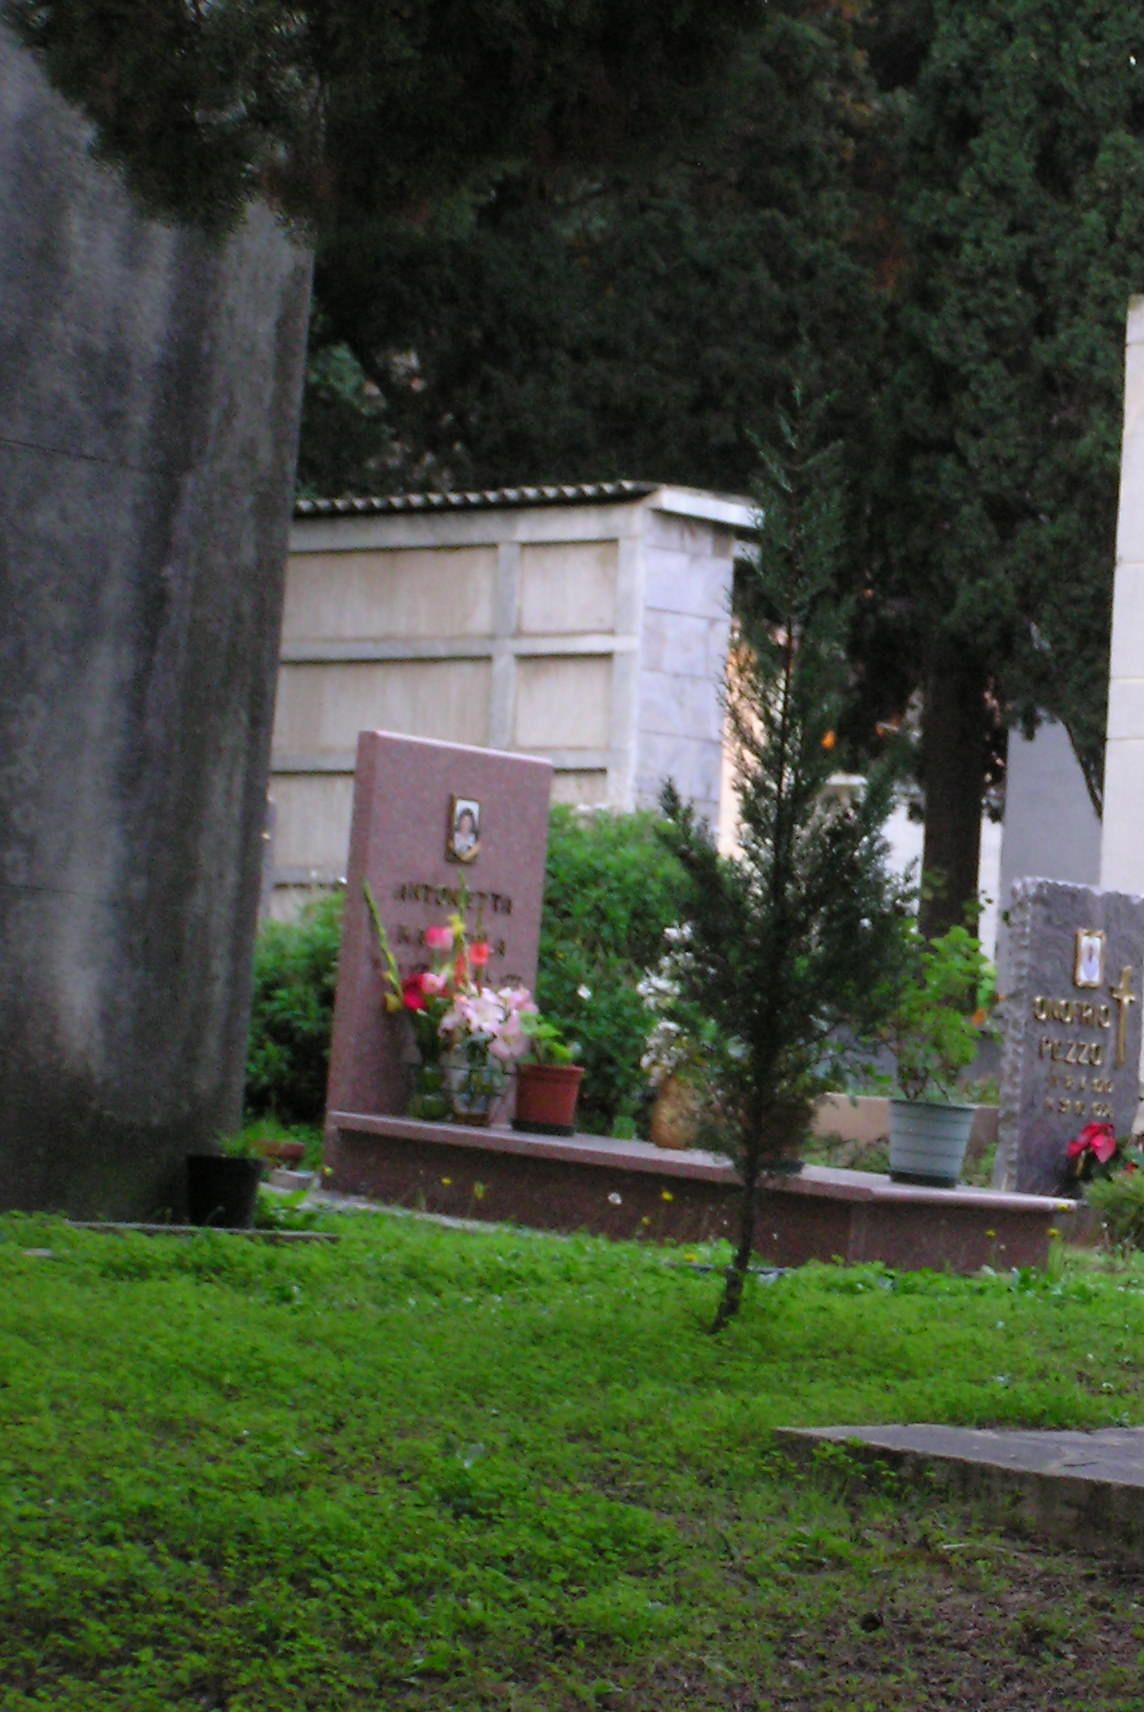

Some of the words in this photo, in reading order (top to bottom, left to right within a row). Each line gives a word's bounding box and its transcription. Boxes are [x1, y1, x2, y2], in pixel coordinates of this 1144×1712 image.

[394, 882, 513, 914] ANTONETTA
[1033, 996, 1112, 1028] ONOFRIO
[1040, 1036, 1104, 1066] PEZZO
